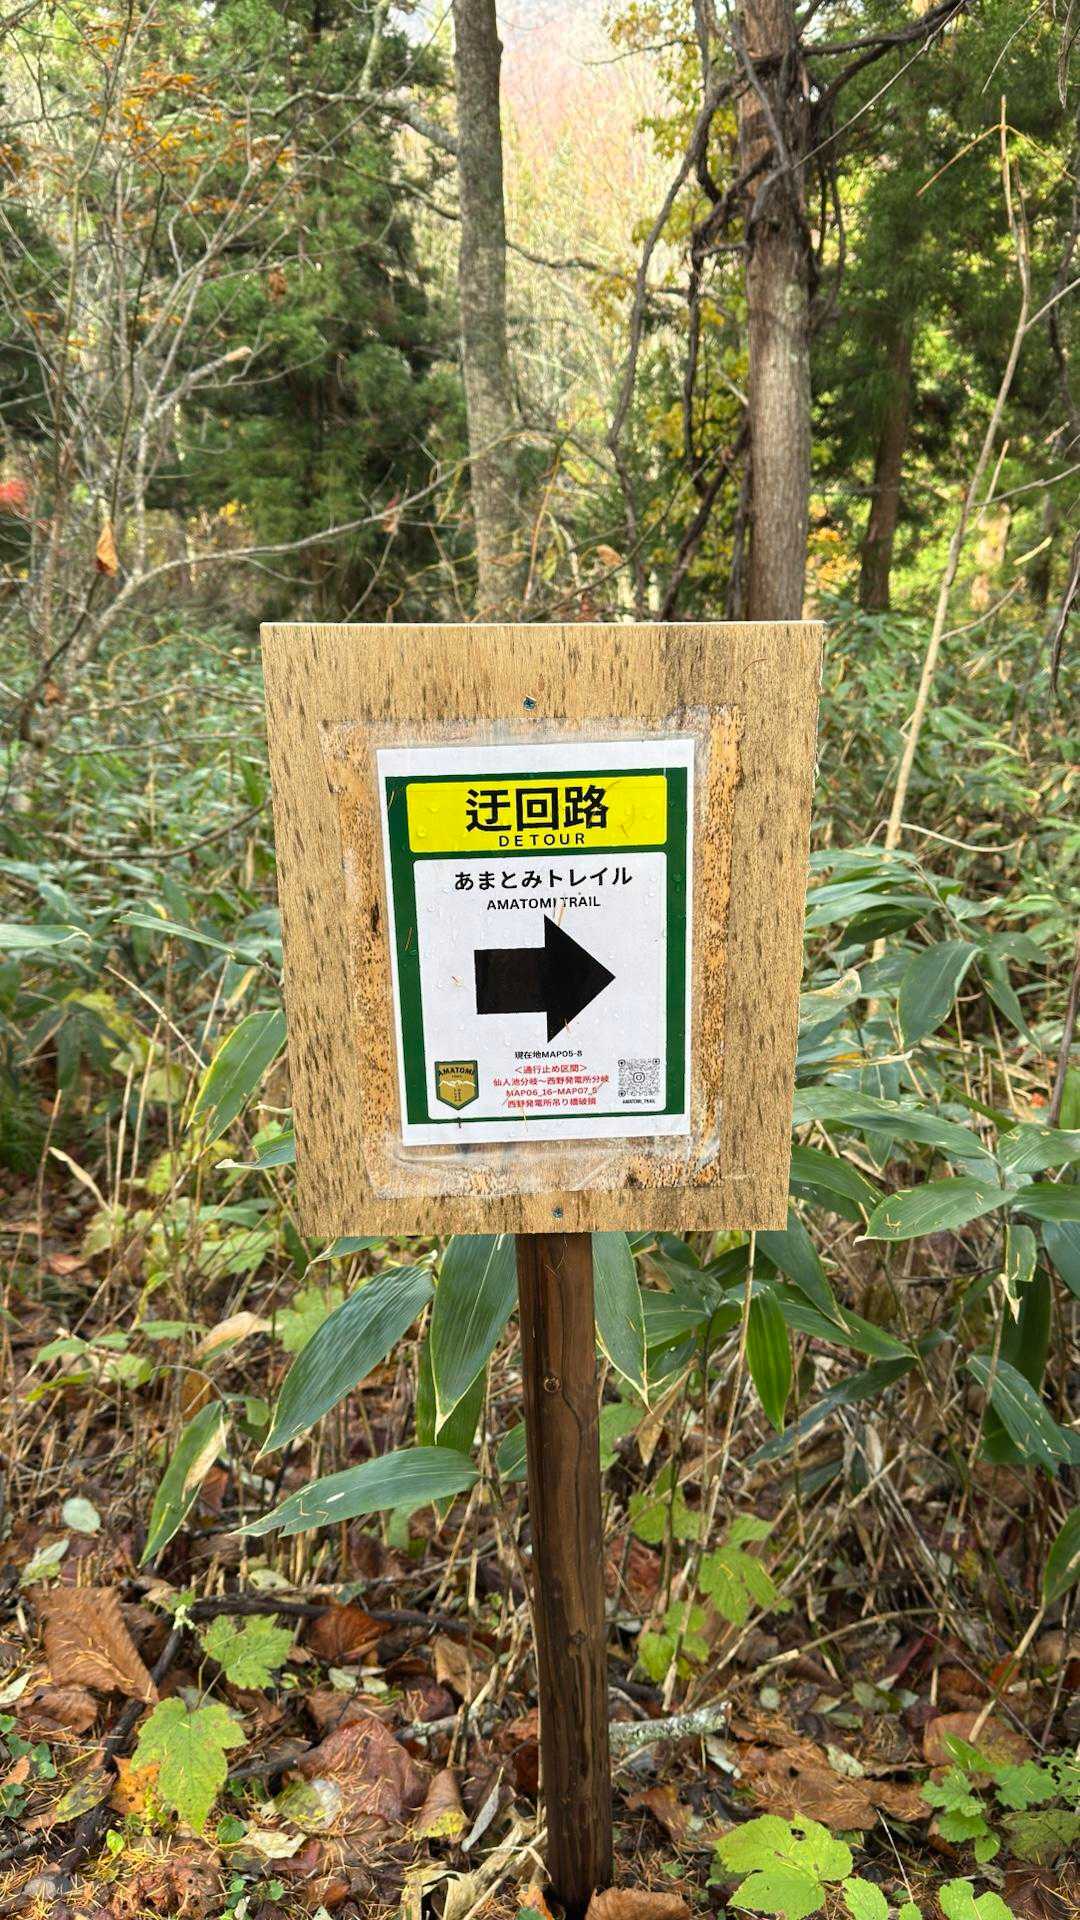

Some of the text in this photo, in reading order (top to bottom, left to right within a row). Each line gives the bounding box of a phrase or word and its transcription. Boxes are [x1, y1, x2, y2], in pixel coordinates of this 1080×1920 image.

[466, 785, 608, 832] 迂回路
[499, 833, 586, 847] DETOUR
[454, 867, 632, 891] あまとみトレイル
[487, 896, 601, 910] AMATOMI TRAIL
